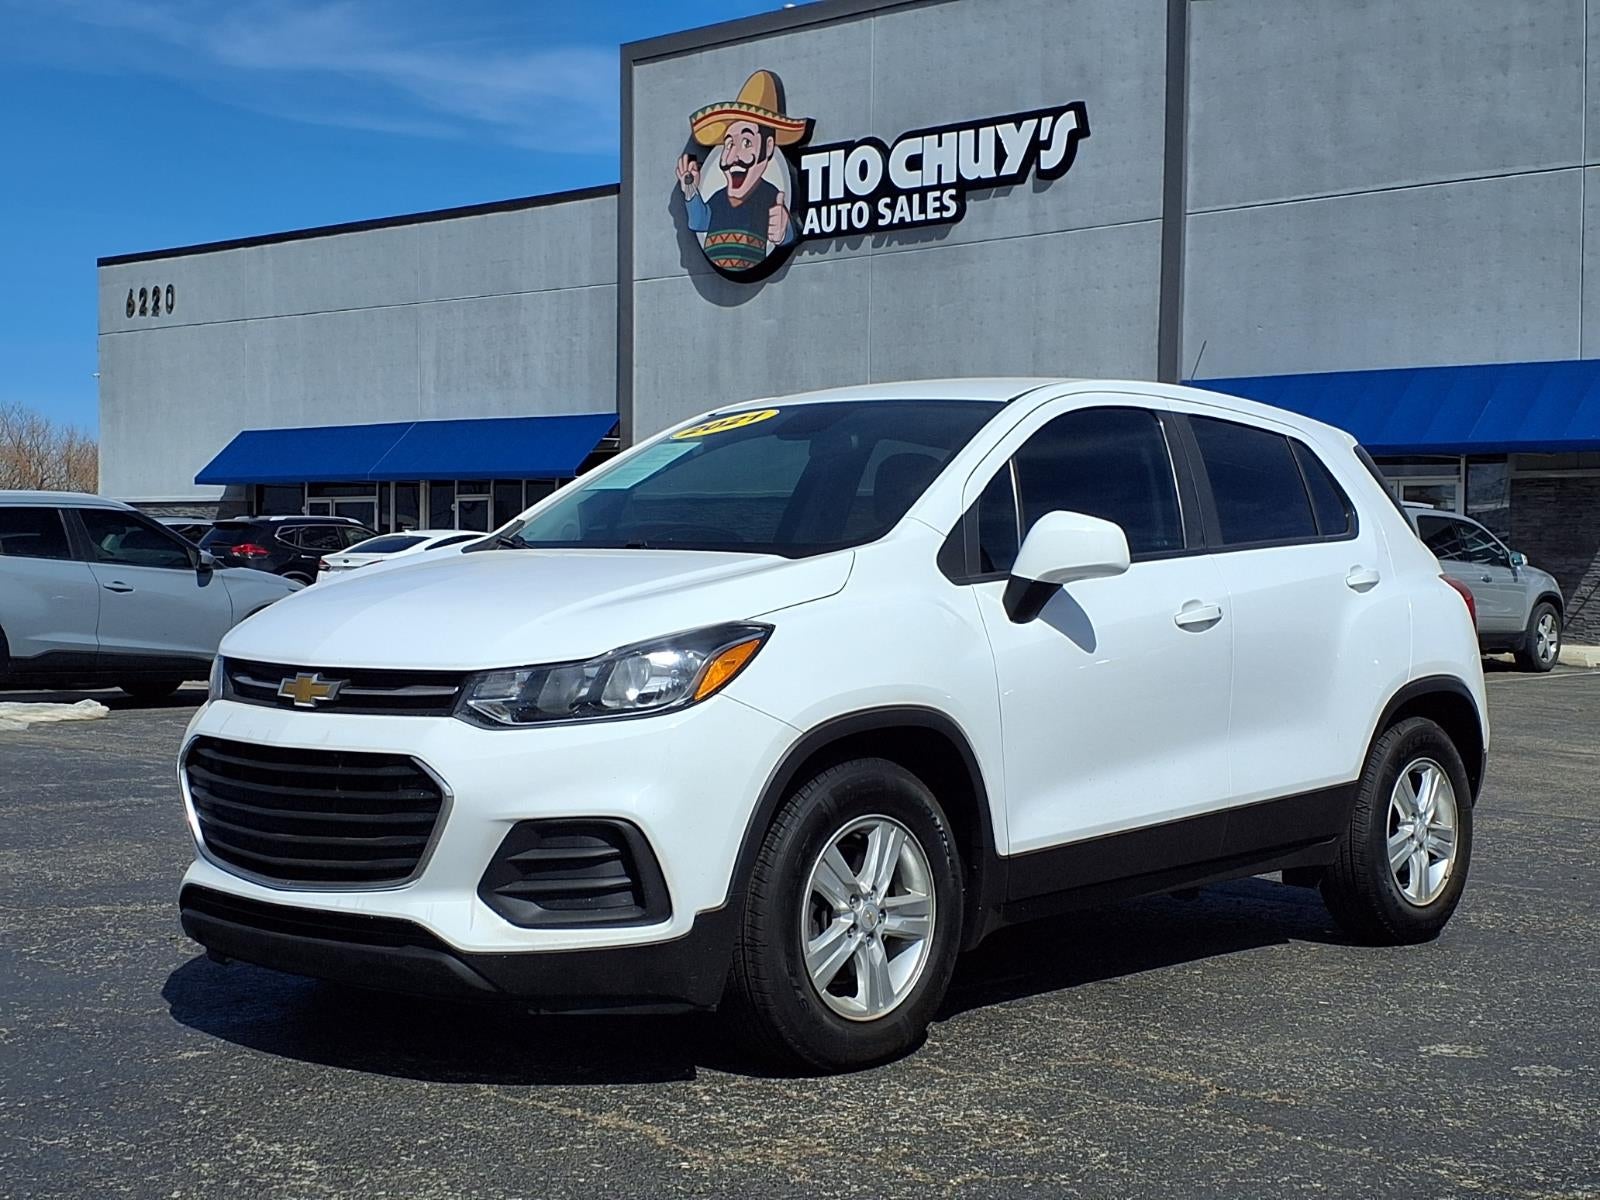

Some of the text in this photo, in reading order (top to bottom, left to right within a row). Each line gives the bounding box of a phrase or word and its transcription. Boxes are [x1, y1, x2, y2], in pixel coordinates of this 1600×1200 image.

[801, 110, 1077, 202] TIO CHUY'S
[802, 189, 958, 235] AUTO SALES
[126, 284, 175, 319] 6220
